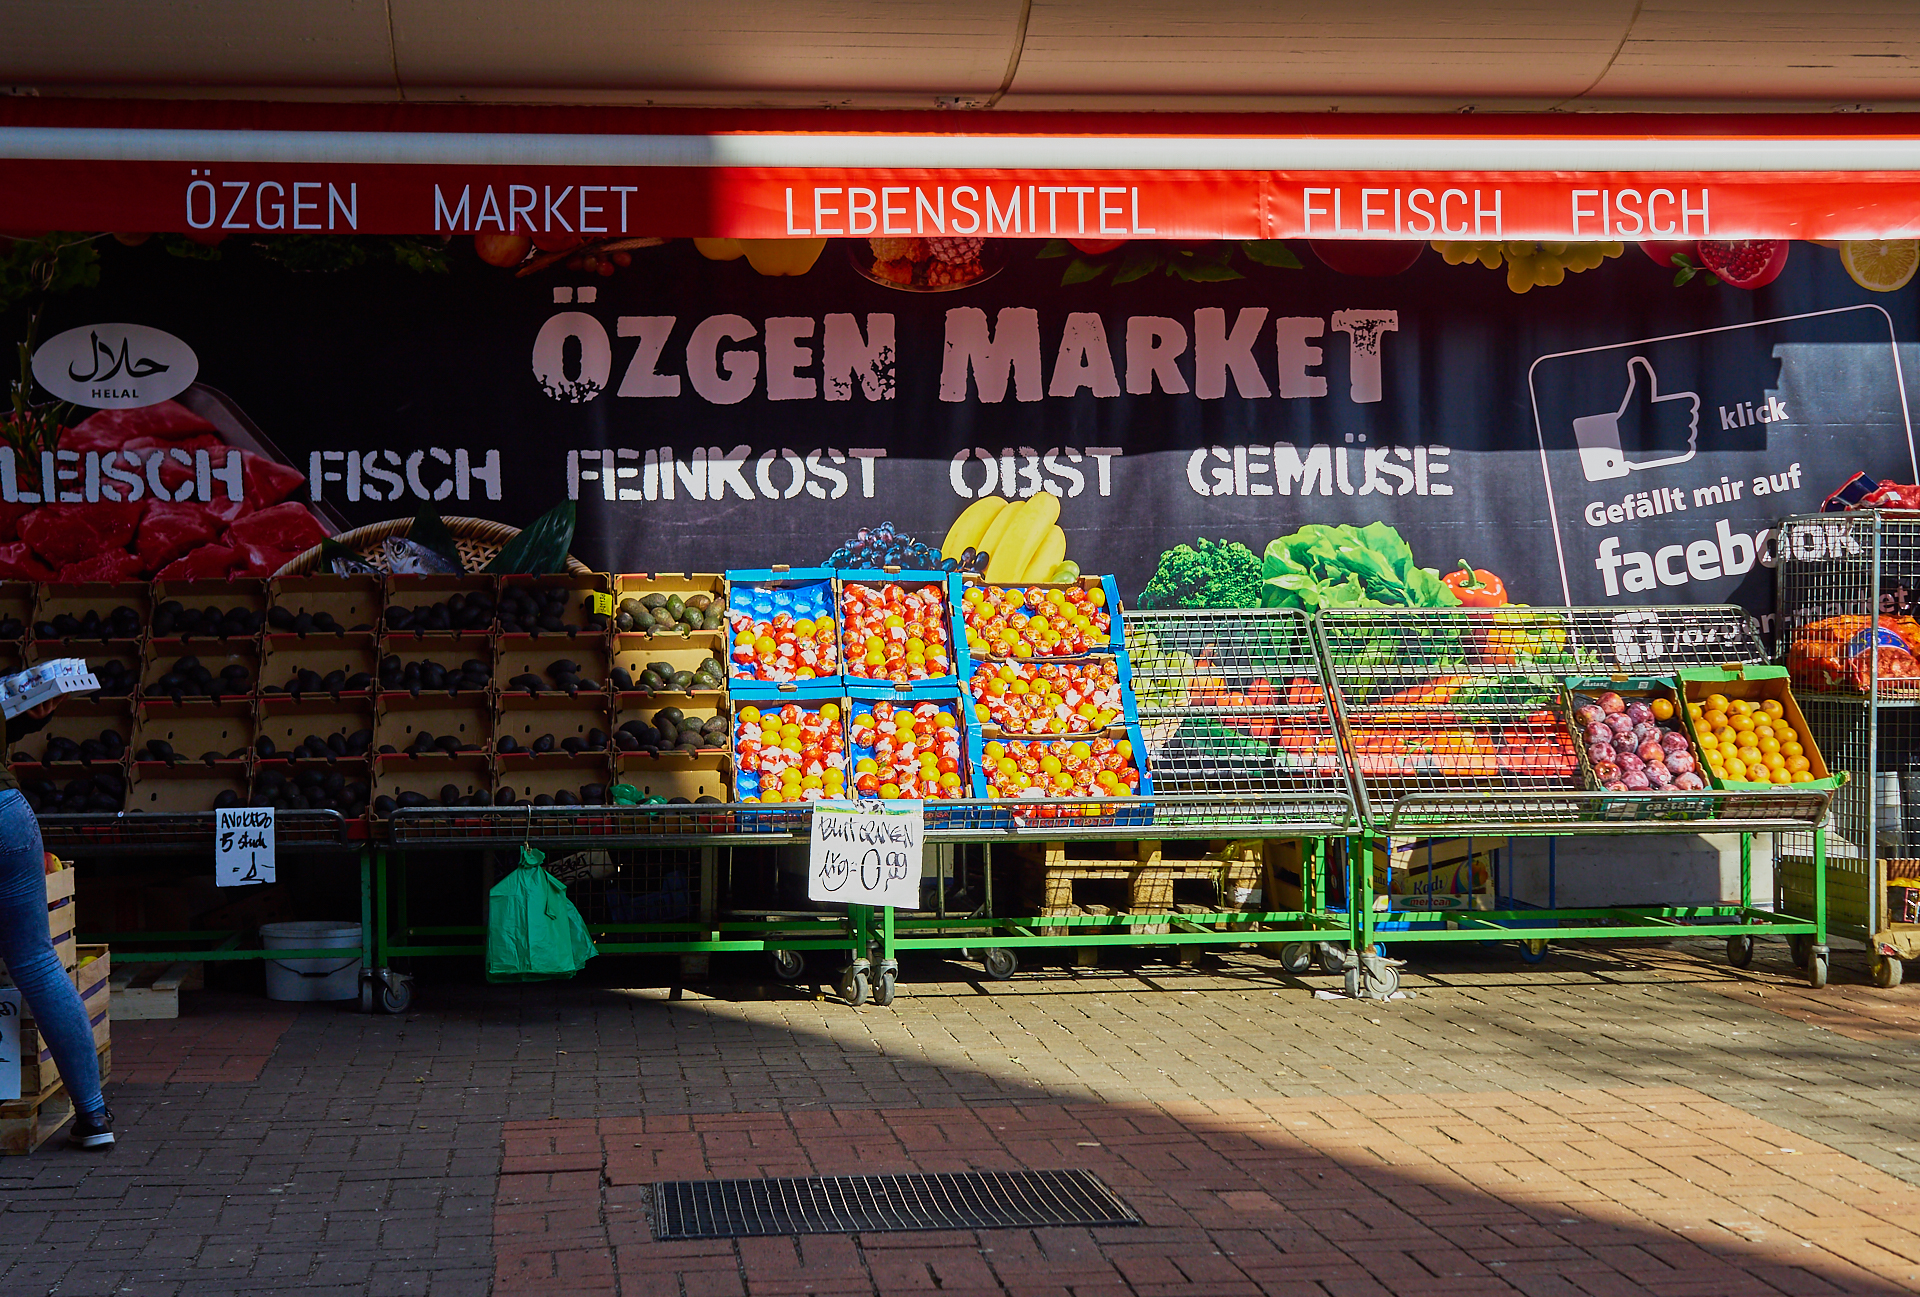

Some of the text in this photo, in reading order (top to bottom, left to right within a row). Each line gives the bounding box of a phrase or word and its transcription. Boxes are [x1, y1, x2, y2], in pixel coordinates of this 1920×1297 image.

[186, 169, 1710, 236] ÖZGEN MARKET LEBENSMITTEL FLEISCH FISCH
[68, 330, 170, 383] حلال
[532, 286, 1399, 404] ÖZGEN MARKET
[91, 389, 140, 399] HELAL
[1719, 395, 1790, 431] klick
[309, 447, 502, 502] FISCH
[567, 444, 887, 502] FEINKOST
[949, 446, 1124, 499] OBST
[1186, 433, 1454, 498] GEMÜSE
[1584, 463, 1802, 527] Gefällt mir auf
[219, 832, 235, 853] 5
